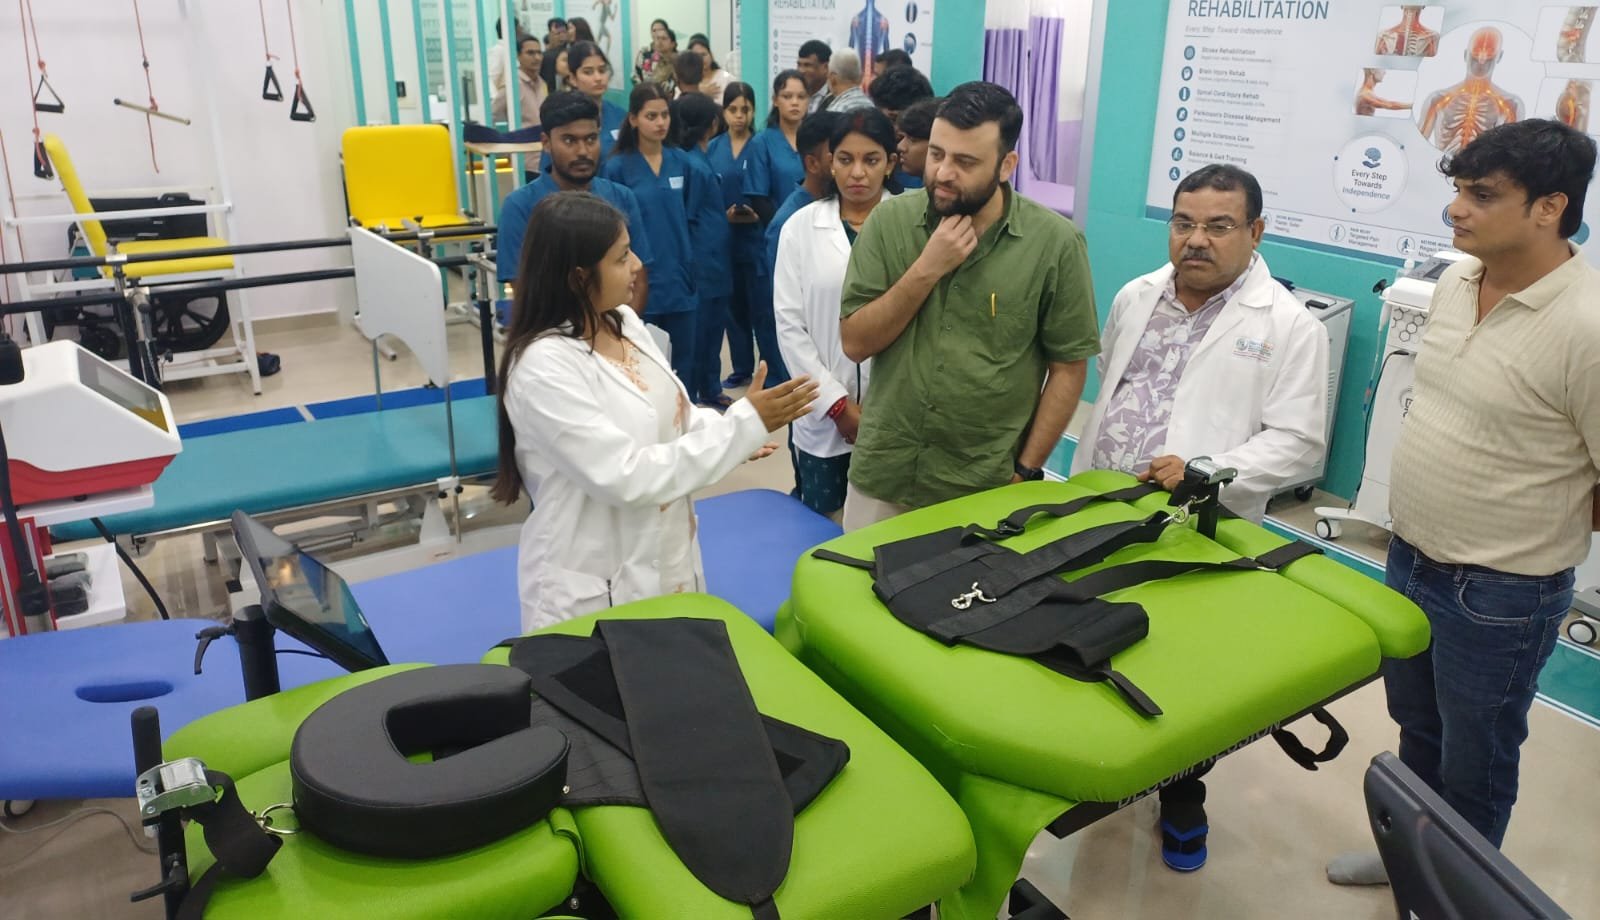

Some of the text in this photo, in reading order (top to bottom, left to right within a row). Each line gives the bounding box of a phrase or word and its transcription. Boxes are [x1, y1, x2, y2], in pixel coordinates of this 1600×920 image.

[1188, 0, 1330, 20] REHABILITATION
[1245, 114, 1281, 124] Management
[1351, 169, 1388, 182] Every Step
[1353, 178, 1383, 189] Towards
[1342, 187, 1391, 200] Independence
